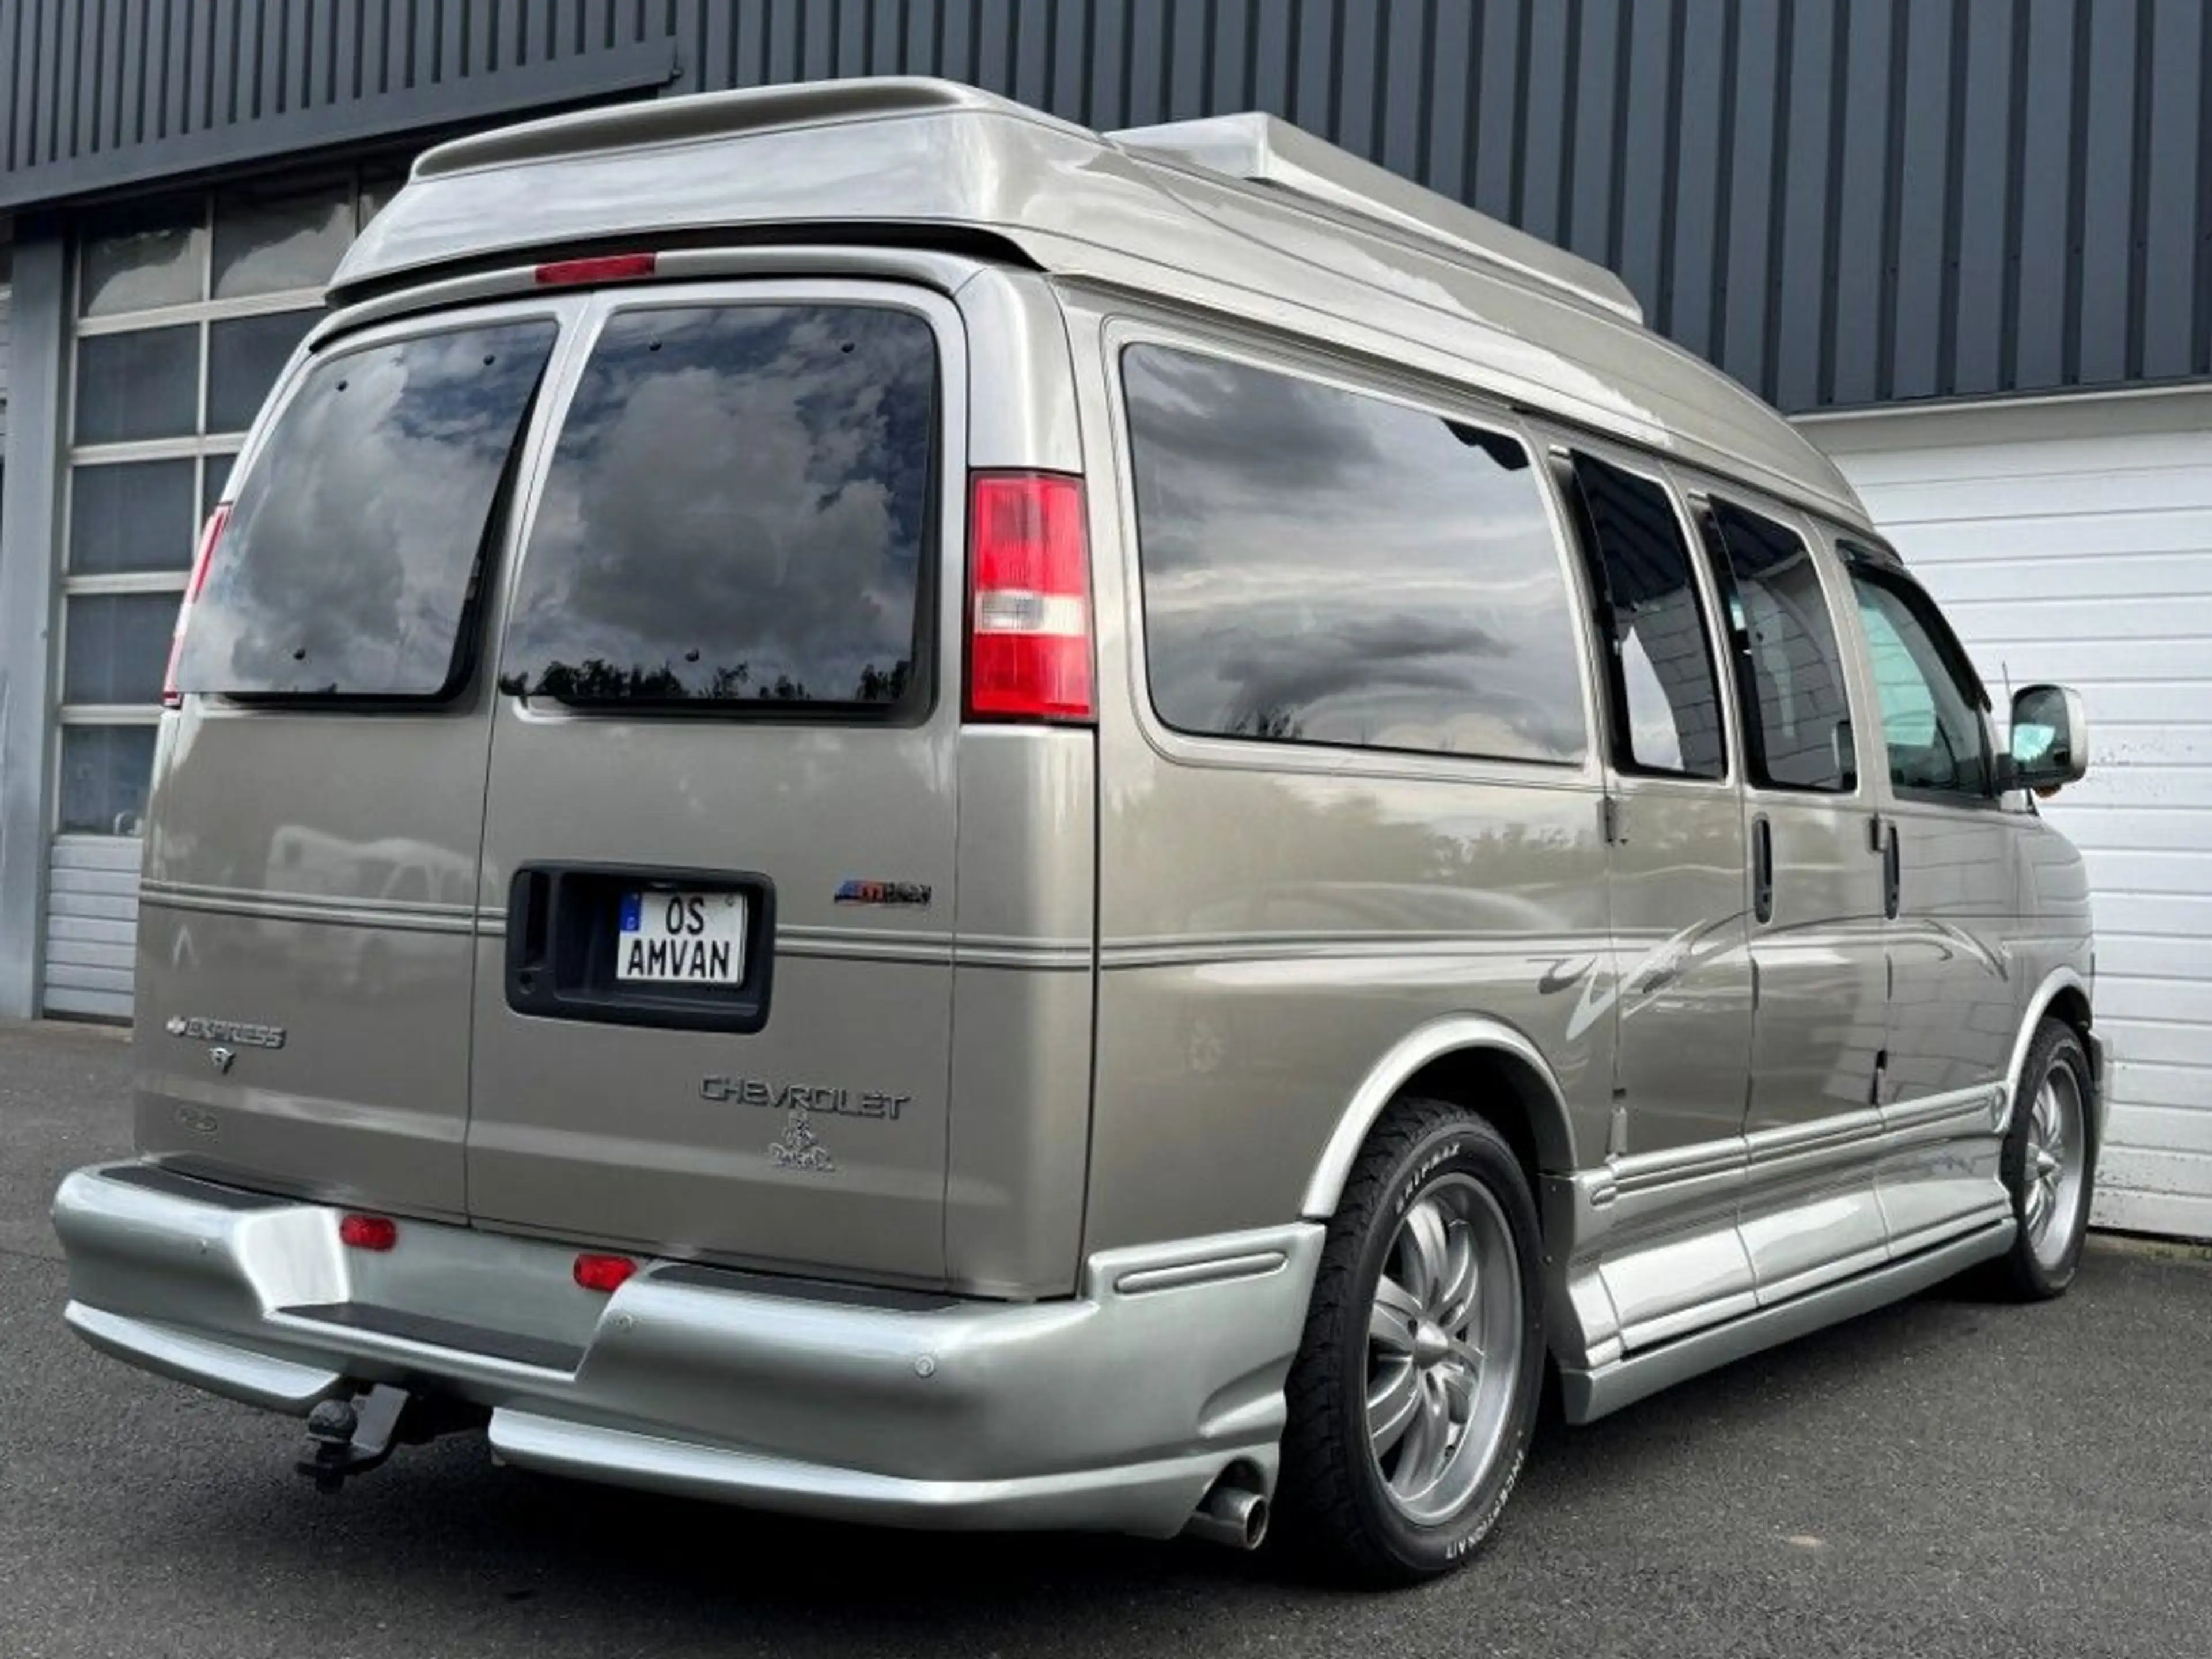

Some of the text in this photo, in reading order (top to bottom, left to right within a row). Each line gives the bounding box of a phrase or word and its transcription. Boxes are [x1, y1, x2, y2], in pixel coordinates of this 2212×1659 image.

[666, 896, 705, 935] OS
[627, 938, 730, 978] AMVAN
[699, 1075, 911, 1120] CHEVROLET
